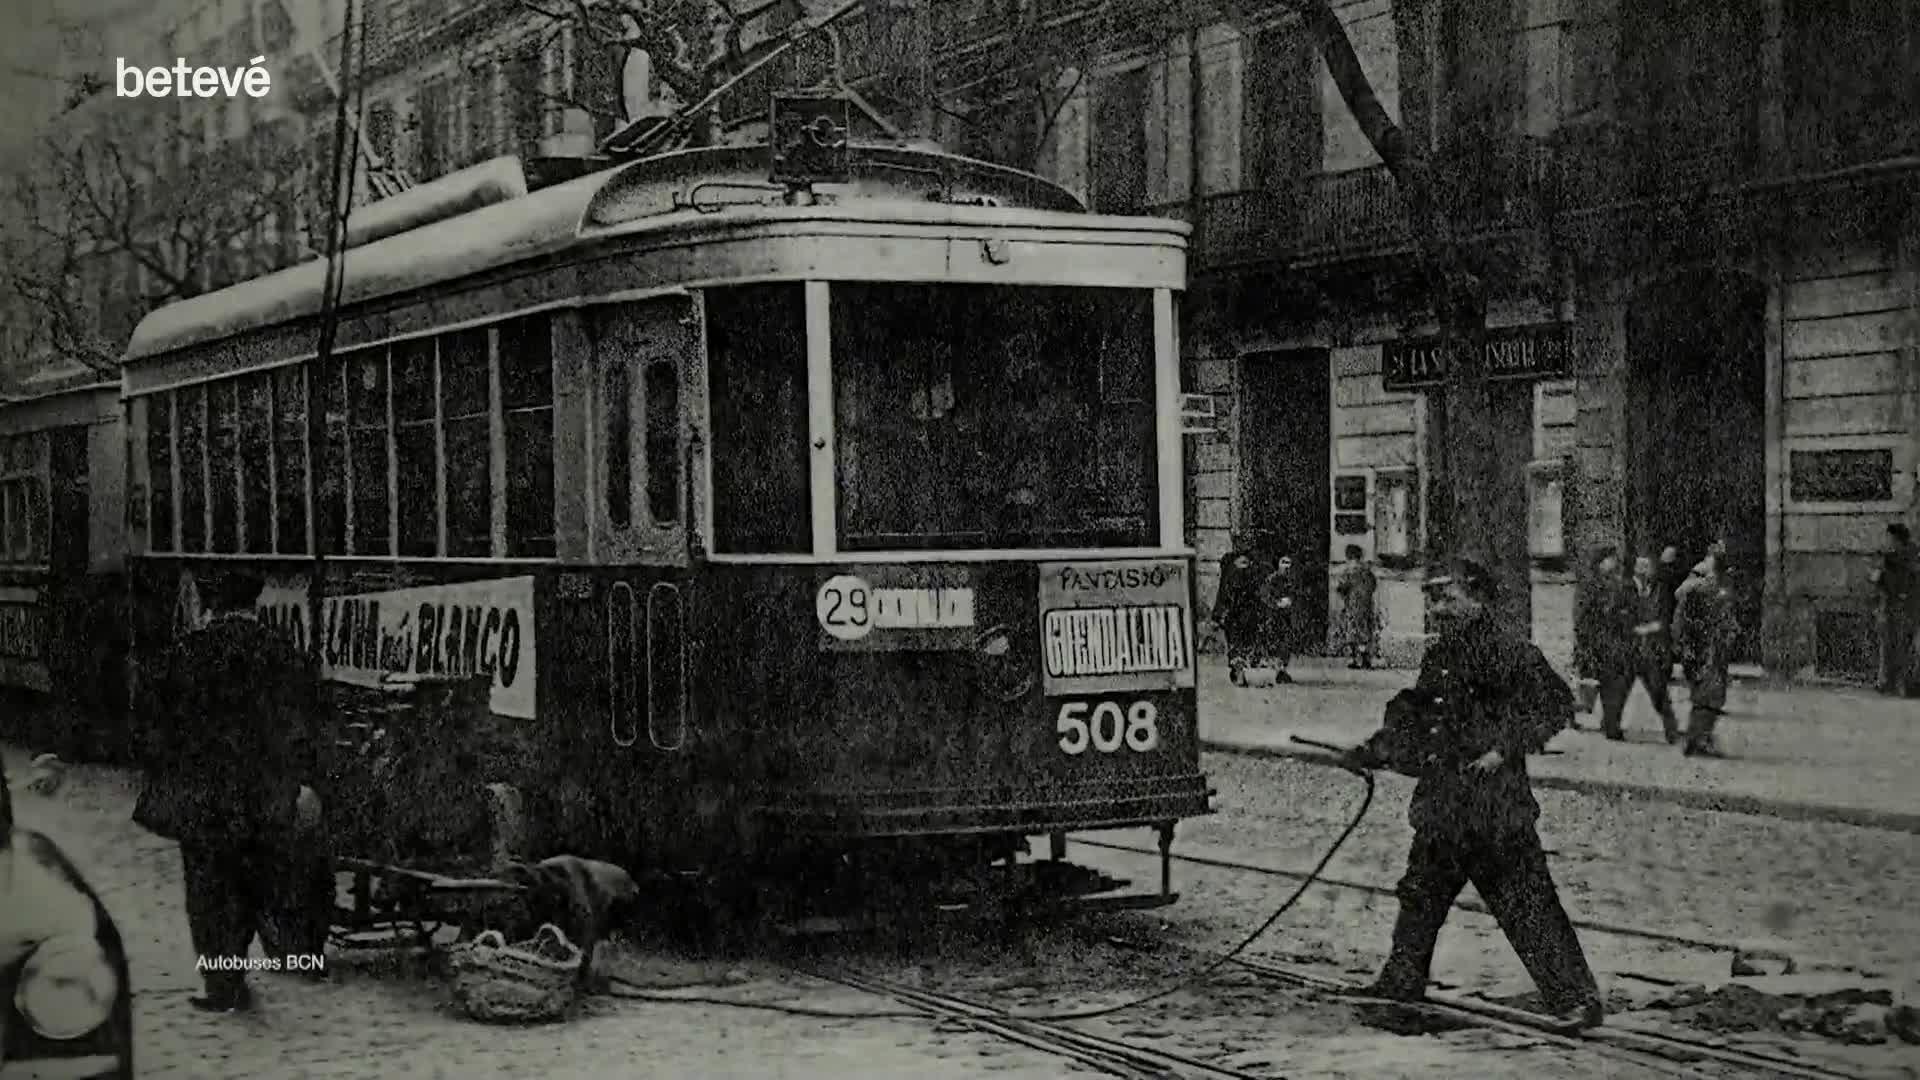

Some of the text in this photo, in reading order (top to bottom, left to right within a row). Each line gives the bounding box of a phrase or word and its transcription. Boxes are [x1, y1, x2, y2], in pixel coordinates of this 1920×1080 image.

[825, 588, 869, 626] 29
[416, 601, 520, 688] BLANCO
[1056, 700, 1158, 755] 508
